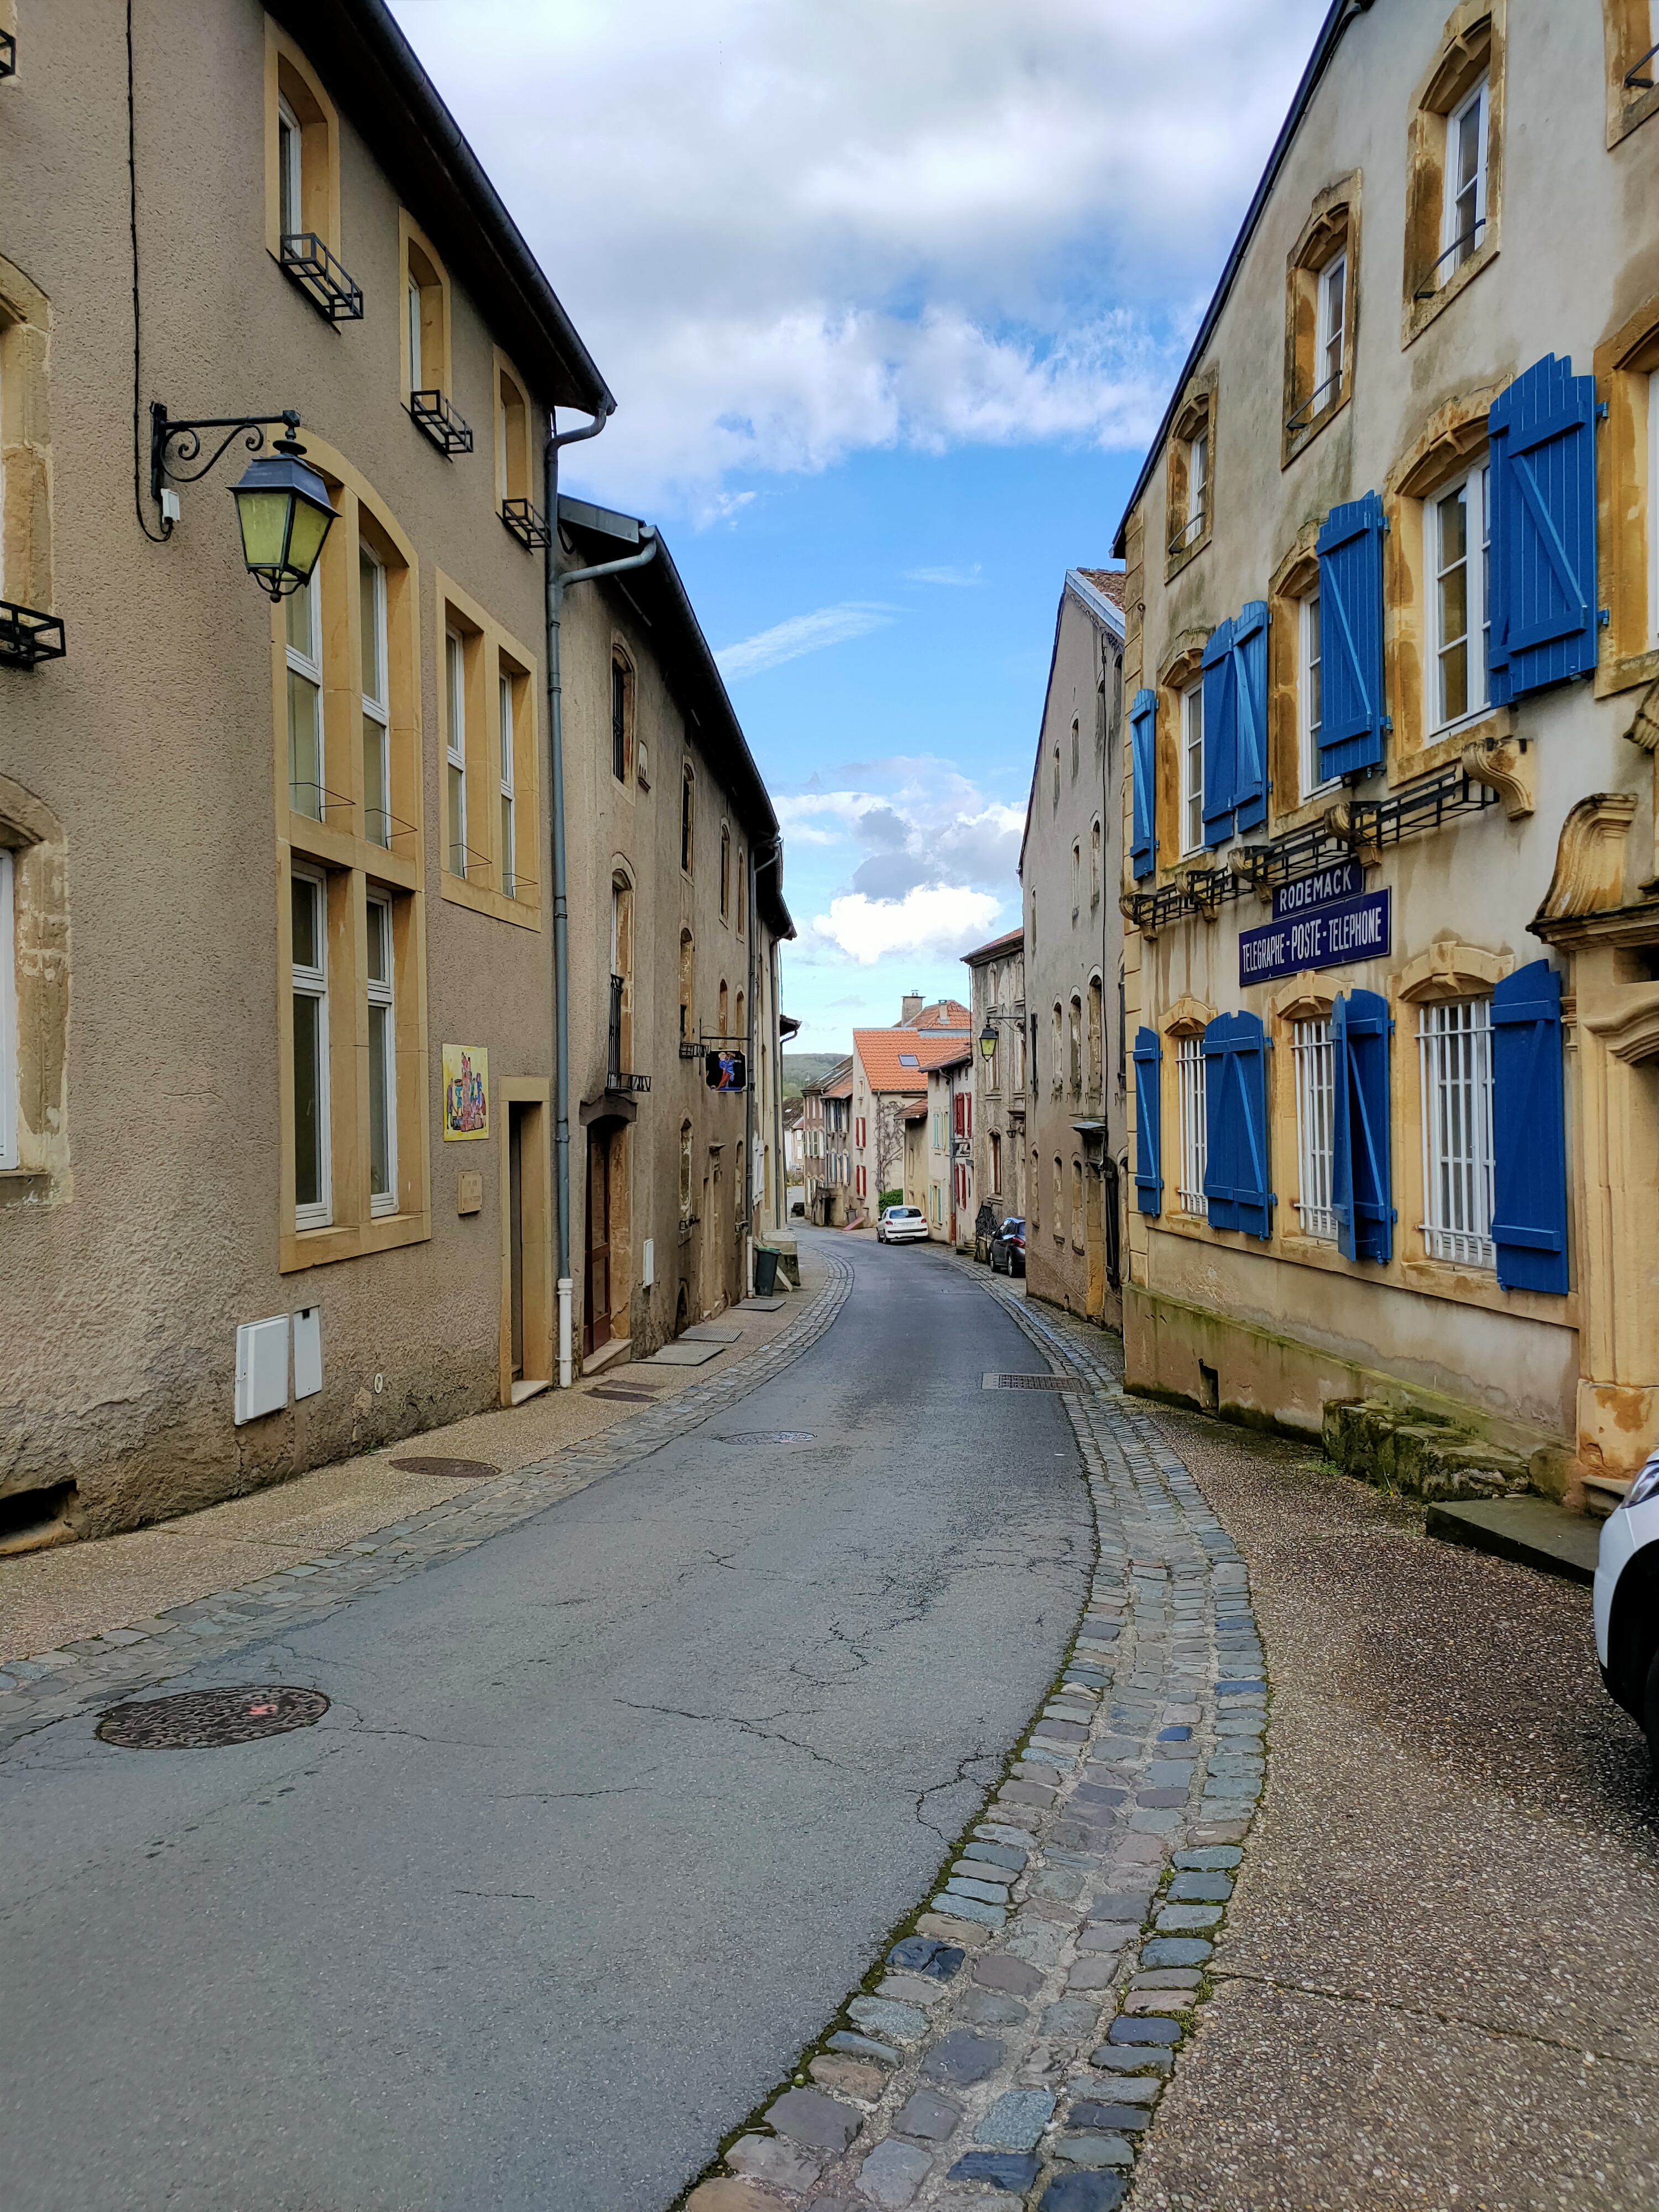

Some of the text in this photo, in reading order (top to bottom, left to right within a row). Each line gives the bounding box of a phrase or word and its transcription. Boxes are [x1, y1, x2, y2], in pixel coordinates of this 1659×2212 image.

[1280, 864, 1352, 912] RODEMACK
[1243, 933, 1285, 973] TELEGRAPHE
[1291, 919, 1322, 961] POSTE
[1328, 906, 1381, 952] TELEPHONE
